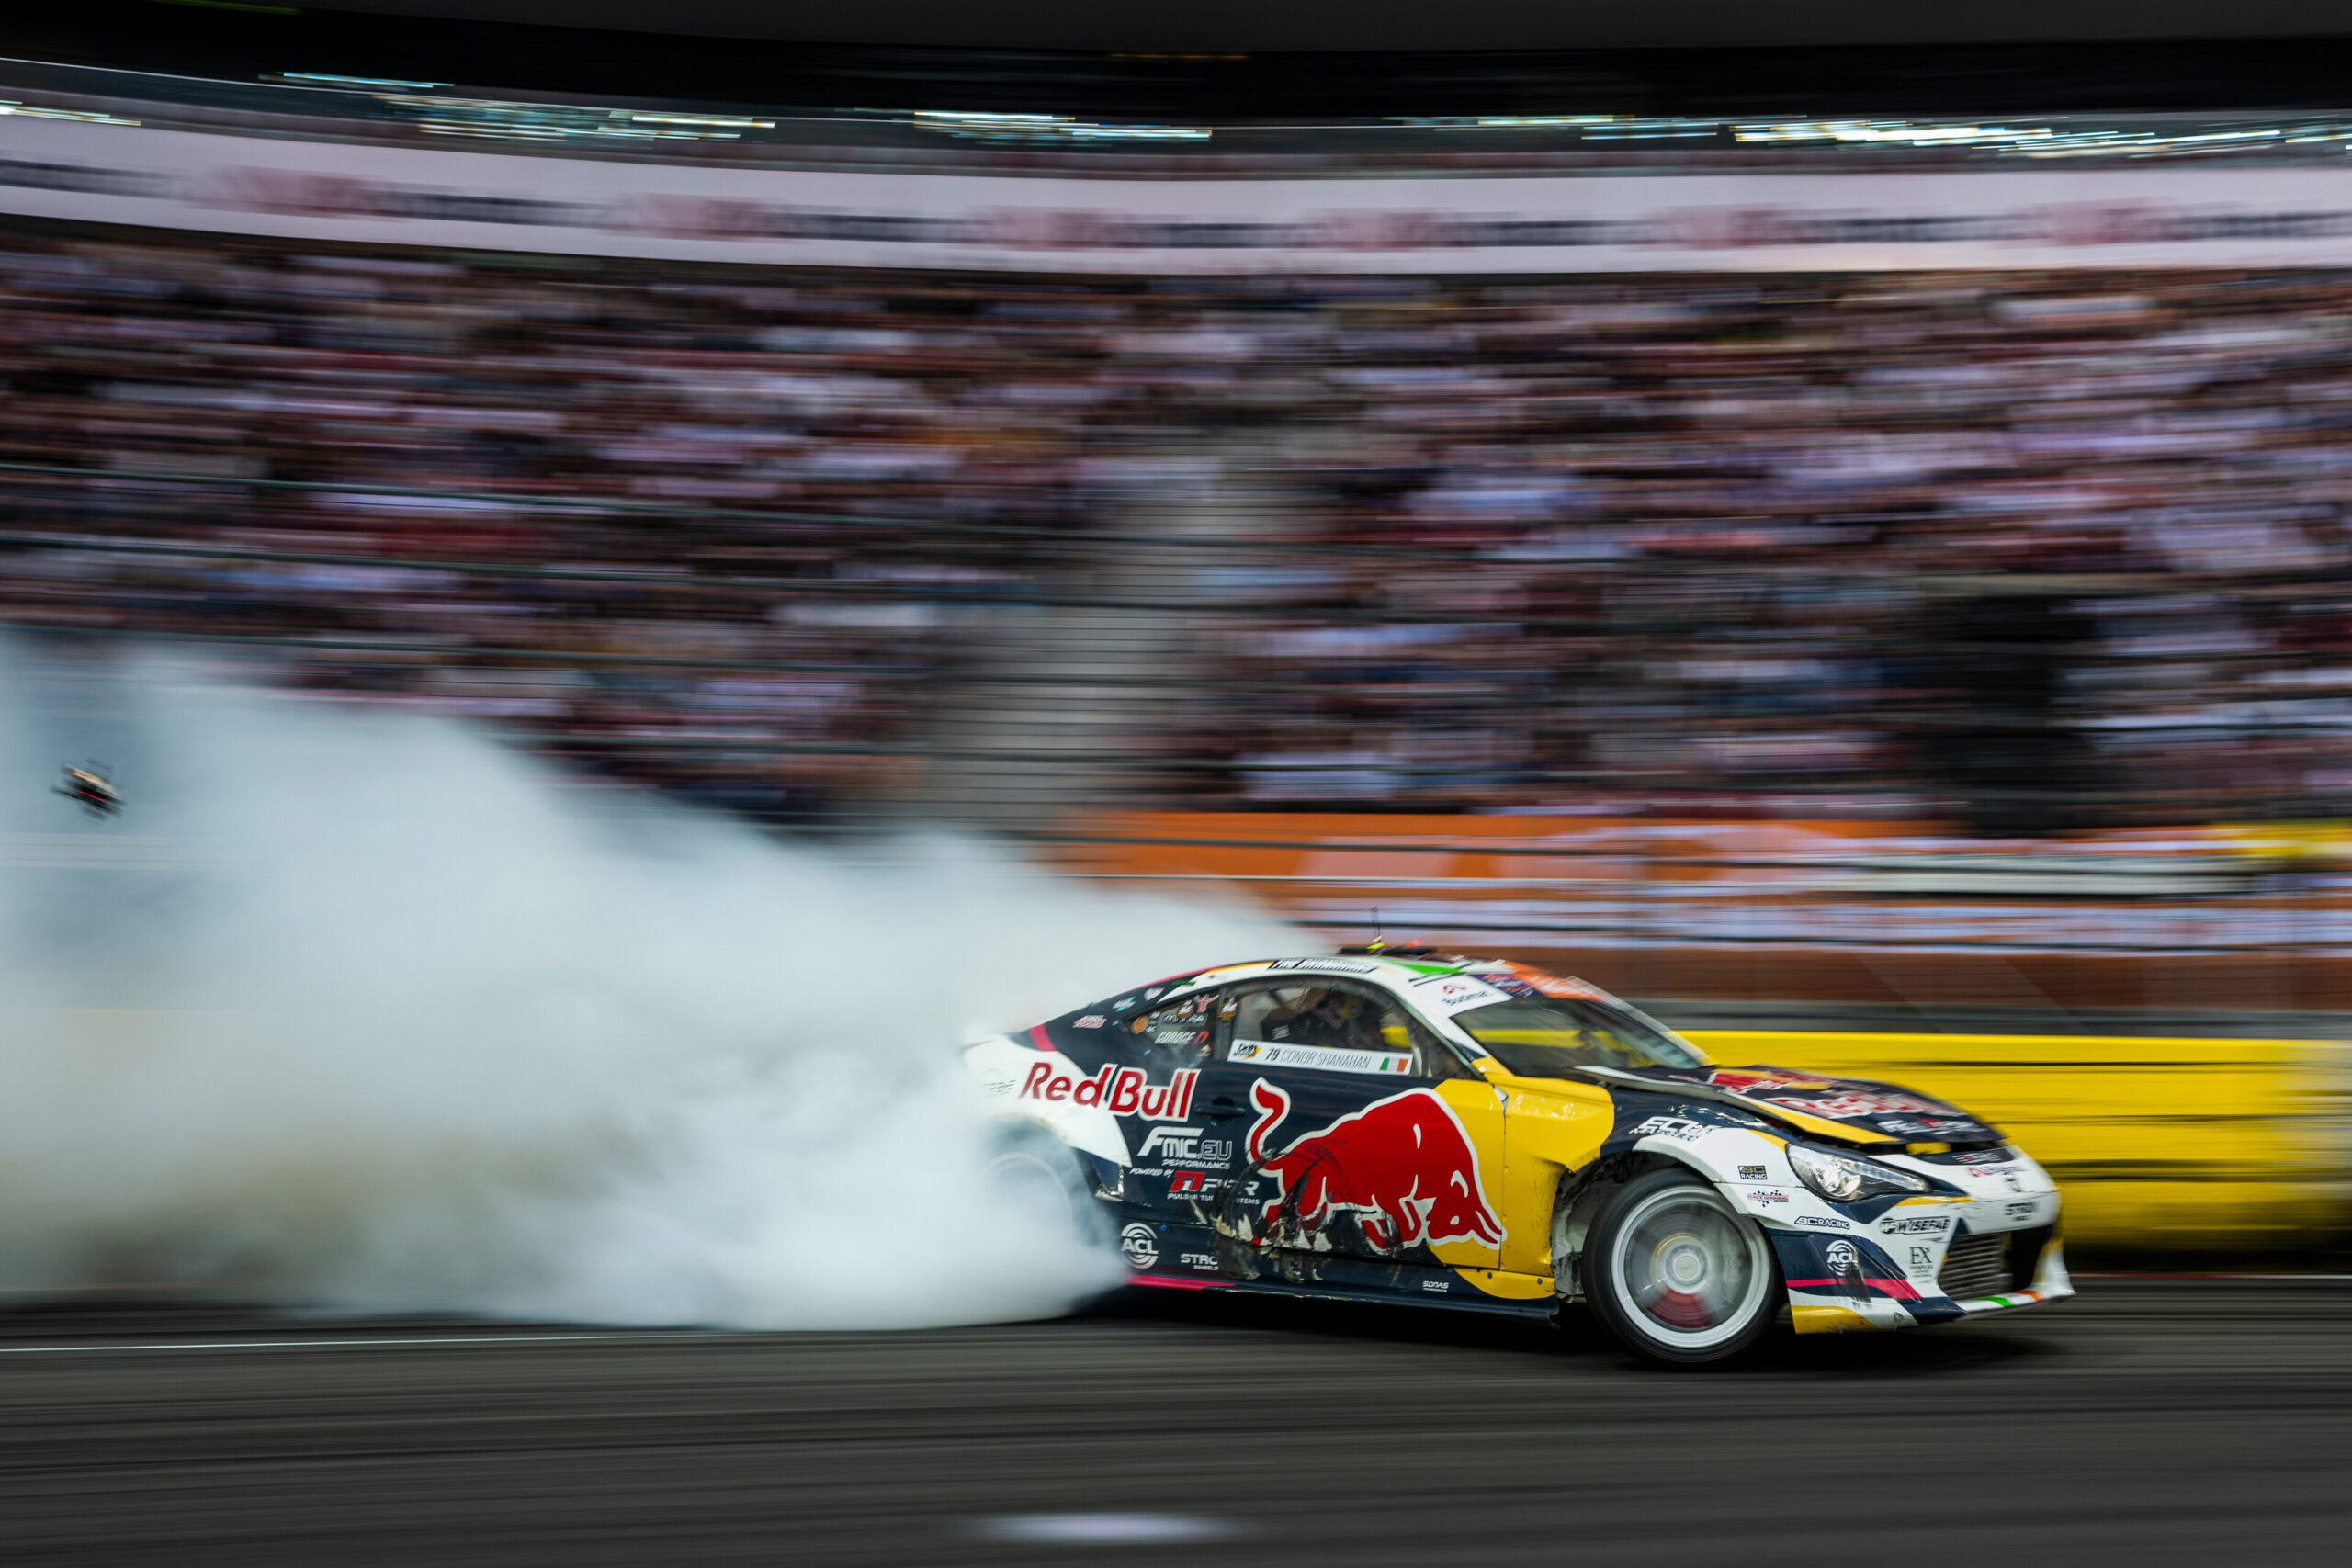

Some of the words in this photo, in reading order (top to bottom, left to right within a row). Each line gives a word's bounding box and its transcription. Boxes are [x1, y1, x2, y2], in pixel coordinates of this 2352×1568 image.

[1265, 1047, 1281, 1062] 79
[1281, 1049, 1317, 1065] CONOR
[1317, 1052, 1372, 1069] SHANAHAN
[1019, 1062, 1113, 1108] Red
[1109, 1069, 1196, 1118] Bull
[1162, 1159, 1231, 1170] PERFORMANCE
[1129, 1168, 1163, 1176] POWERED
[1163, 1169, 1175, 1178] BY
[1818, 1218, 1851, 1230] RACING
[1121, 1238, 1159, 1255] ACL
[1826, 1252, 1858, 1264] ACL
